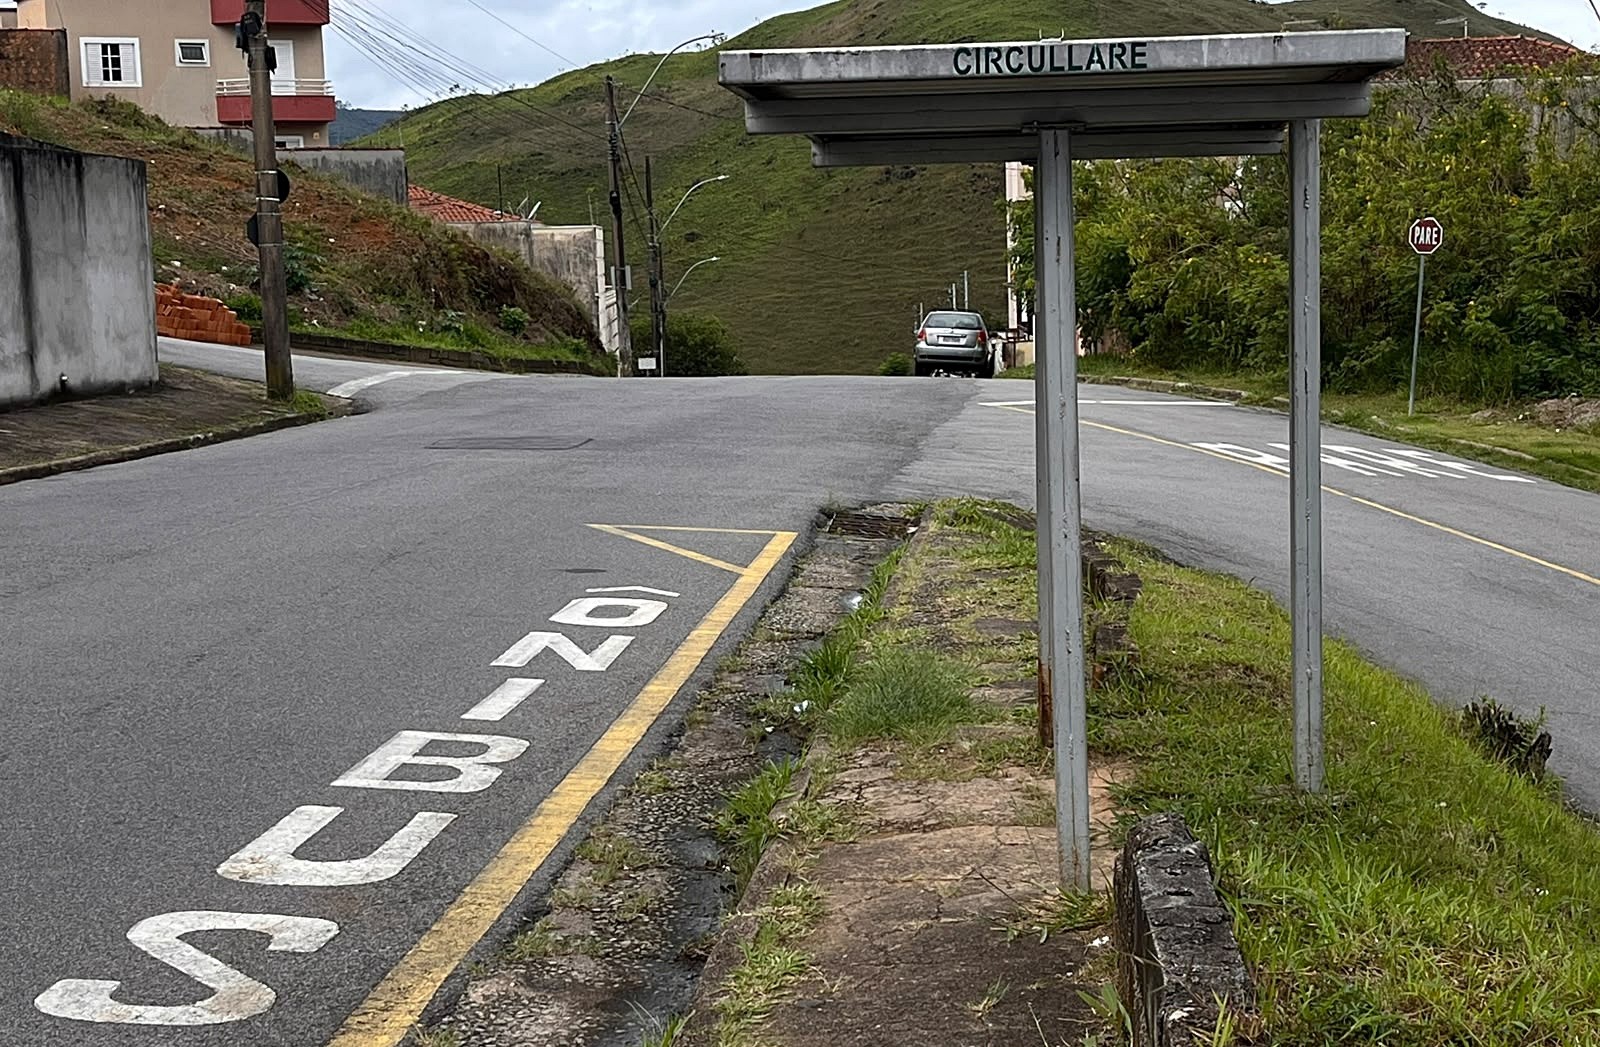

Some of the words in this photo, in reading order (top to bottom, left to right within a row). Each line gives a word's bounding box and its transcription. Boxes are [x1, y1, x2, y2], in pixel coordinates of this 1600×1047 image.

[952, 42, 1148, 76] CIRCULLARE
[1413, 226, 1439, 245] PARE
[1188, 442, 1537, 484] PARE
